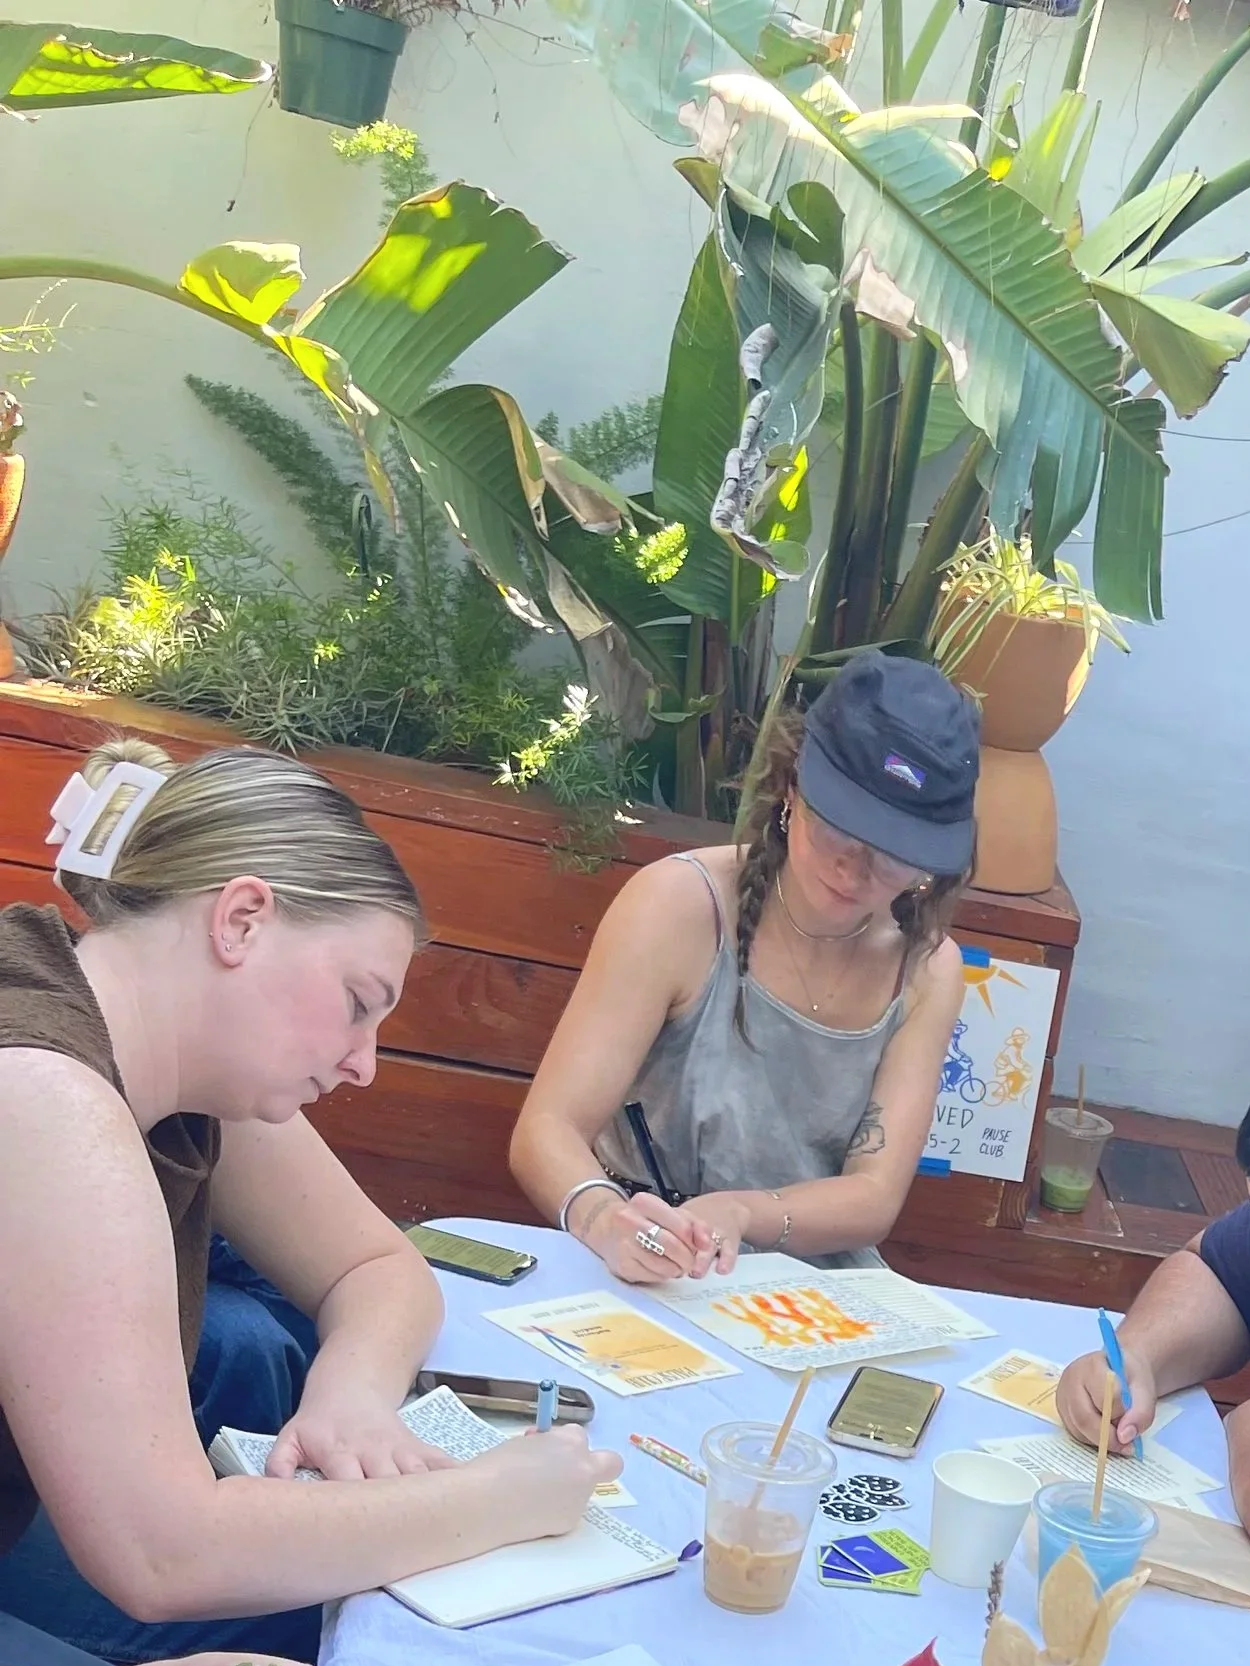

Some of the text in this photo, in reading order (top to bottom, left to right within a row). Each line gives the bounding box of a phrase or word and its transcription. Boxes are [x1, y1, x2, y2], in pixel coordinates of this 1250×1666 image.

[935, 1105, 974, 1129] VED
[982, 1127, 1012, 1144] PAUSE
[979, 1143, 1005, 1157] CLUB
